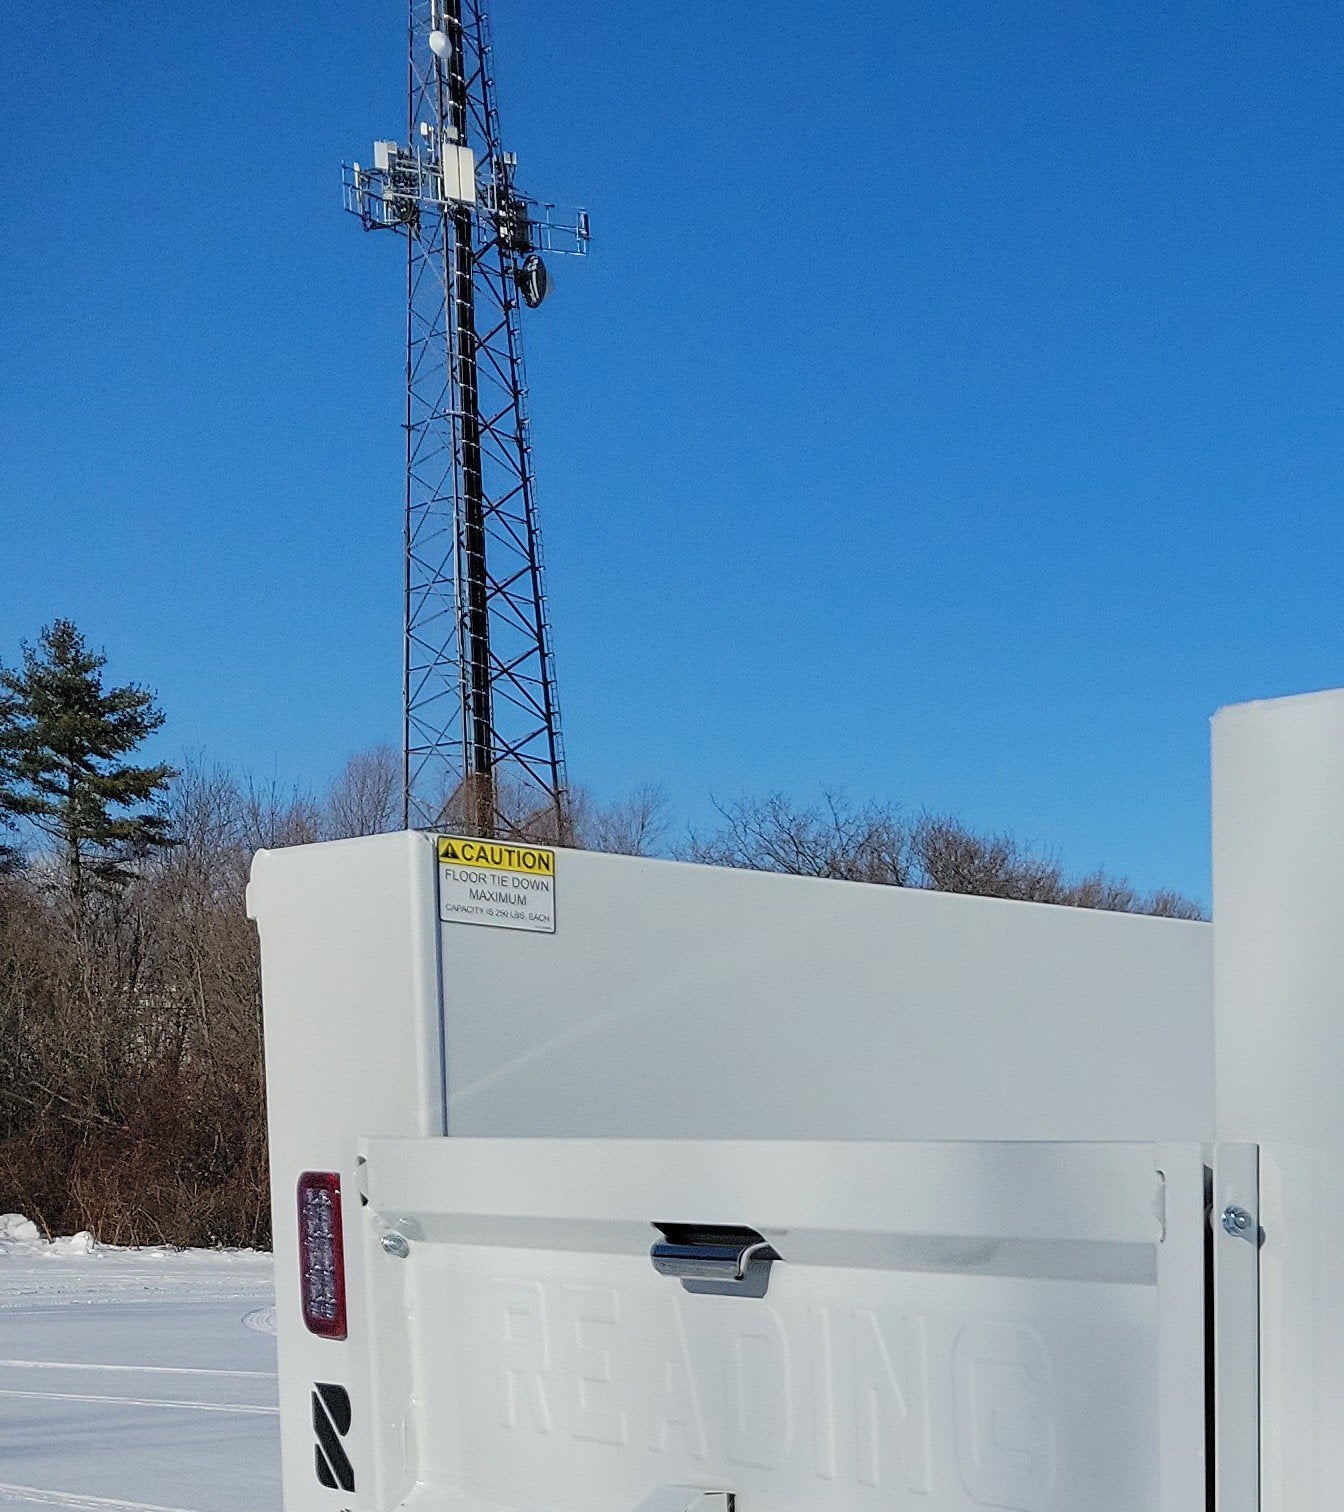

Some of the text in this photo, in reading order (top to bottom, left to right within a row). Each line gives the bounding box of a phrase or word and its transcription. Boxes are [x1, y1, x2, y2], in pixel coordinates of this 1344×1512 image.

[461, 843, 550, 871] CAUTION
[445, 869, 549, 891] FLOOR TIE DOWN
[469, 888, 526, 905] MAXIMUM
[446, 903, 483, 913] CAPACITY
[529, 912, 549, 921] EACH
